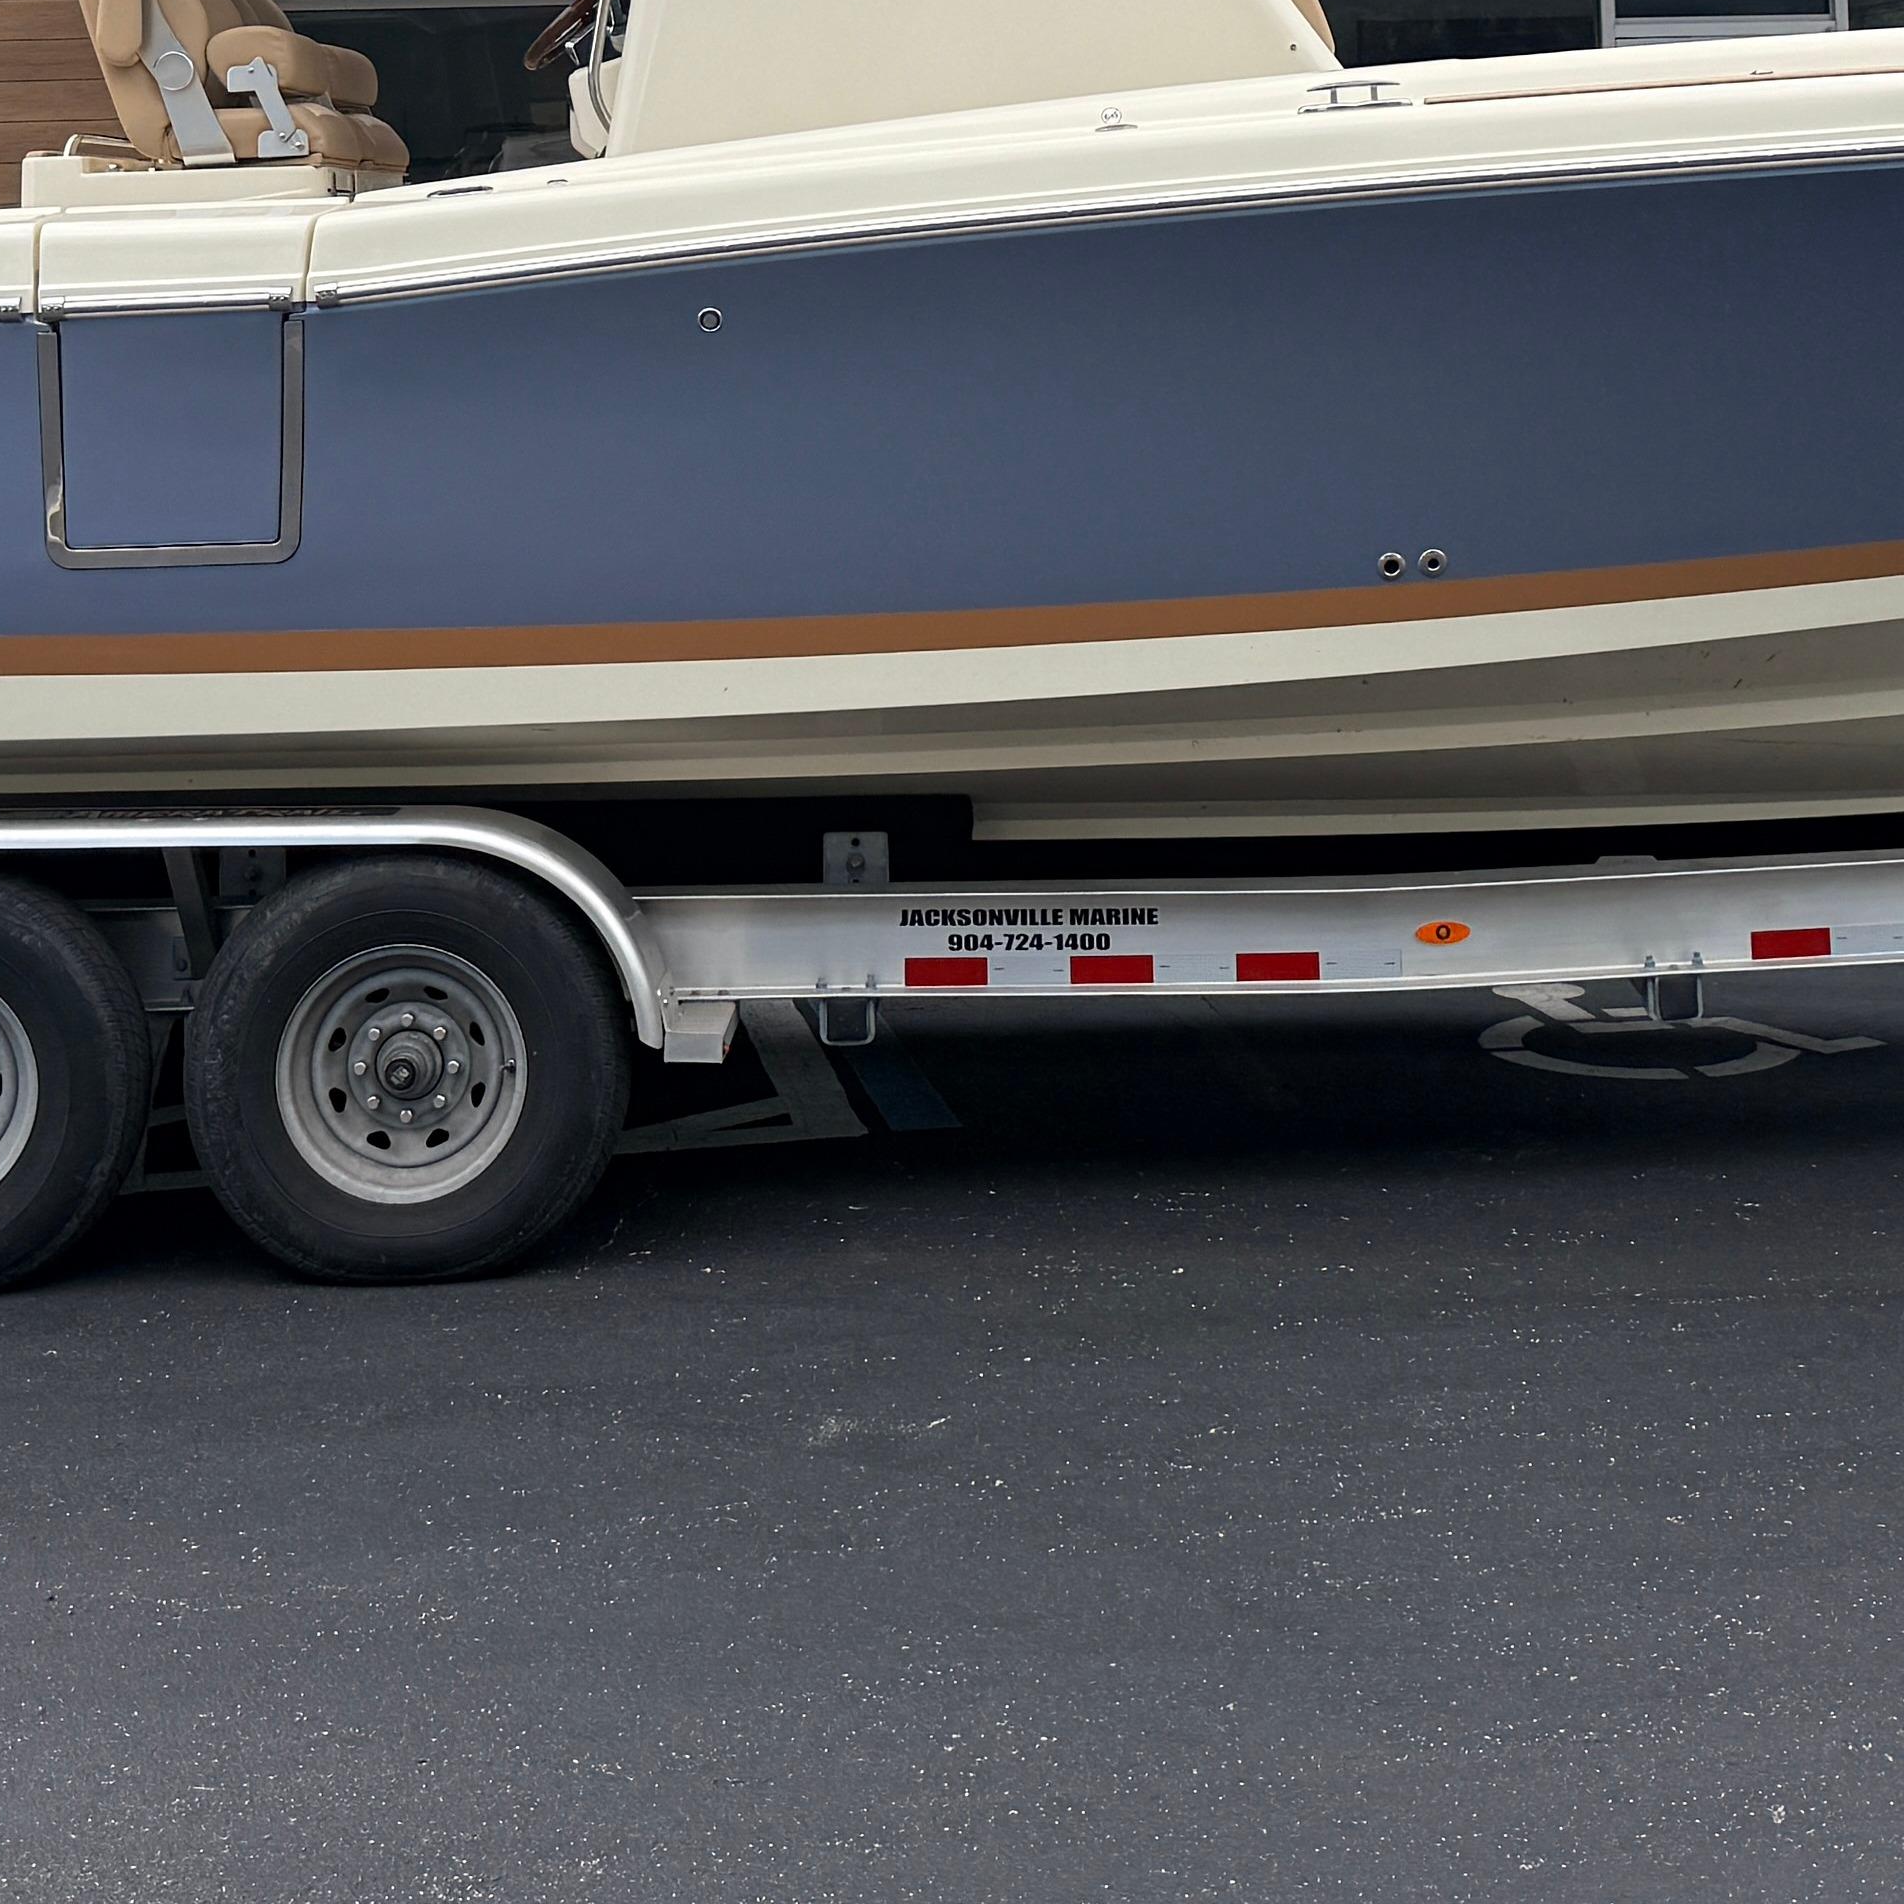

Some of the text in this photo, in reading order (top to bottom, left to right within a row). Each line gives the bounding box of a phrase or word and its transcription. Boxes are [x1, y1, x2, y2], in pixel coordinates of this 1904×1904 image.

[899, 907, 1159, 927] JACKSONVILLE MARINE
[947, 933, 1111, 952] 904-724-1400
